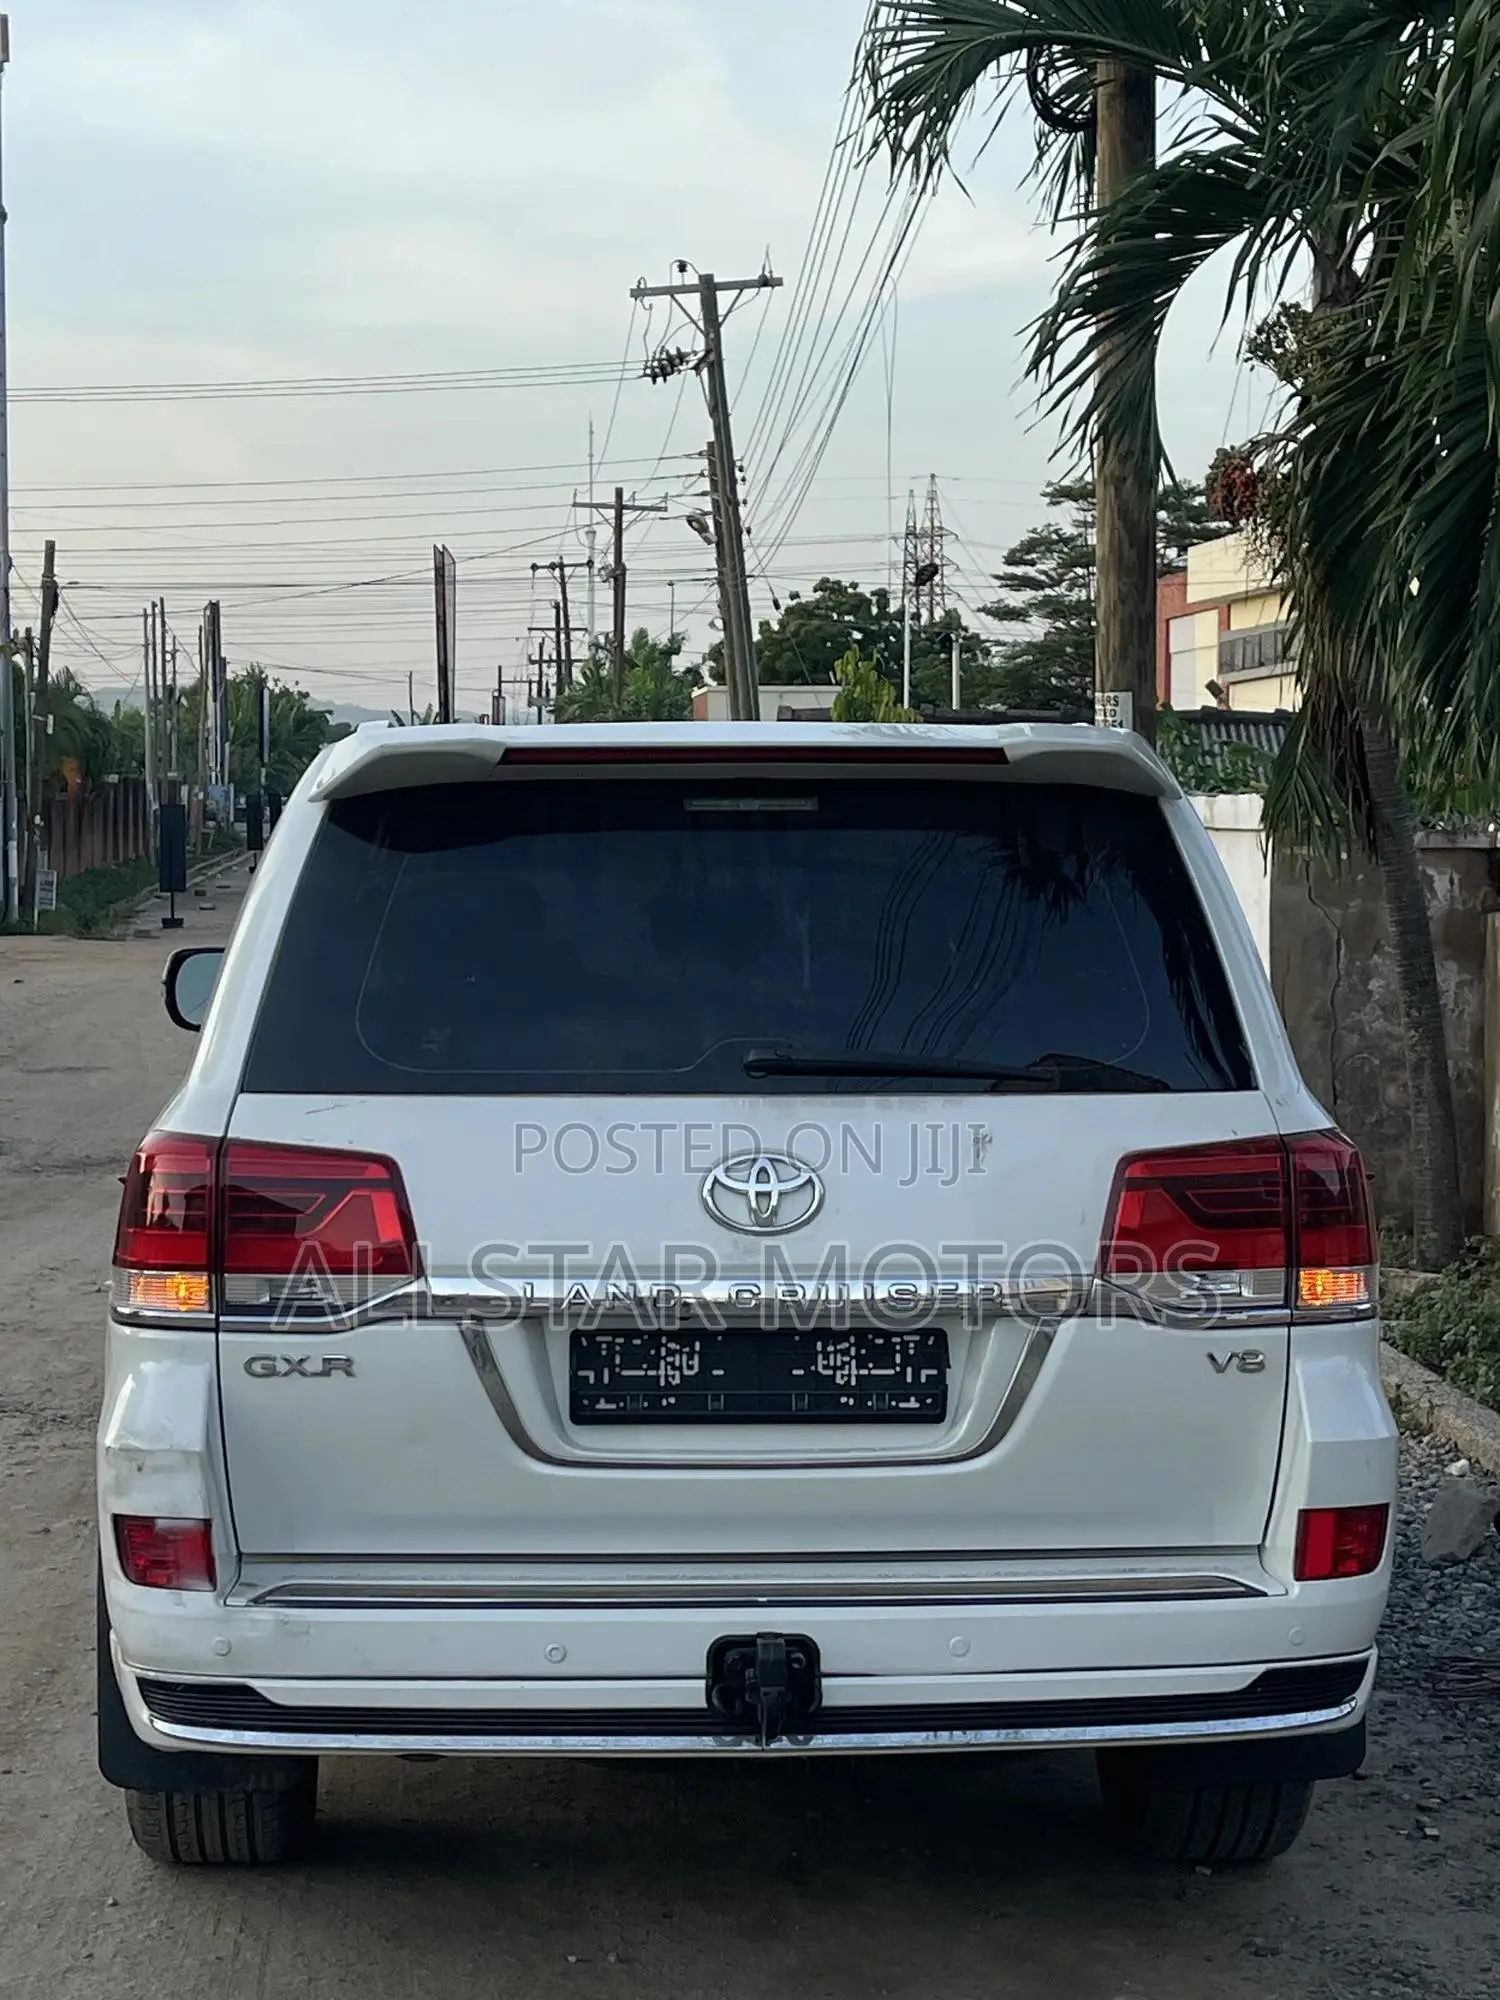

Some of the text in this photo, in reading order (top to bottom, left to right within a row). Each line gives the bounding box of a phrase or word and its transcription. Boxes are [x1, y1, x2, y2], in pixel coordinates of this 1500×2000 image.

[524, 1280, 1004, 1310] LAND CRUISER
[243, 1353, 357, 1378] GXR
[1204, 1348, 1267, 1374] V8
